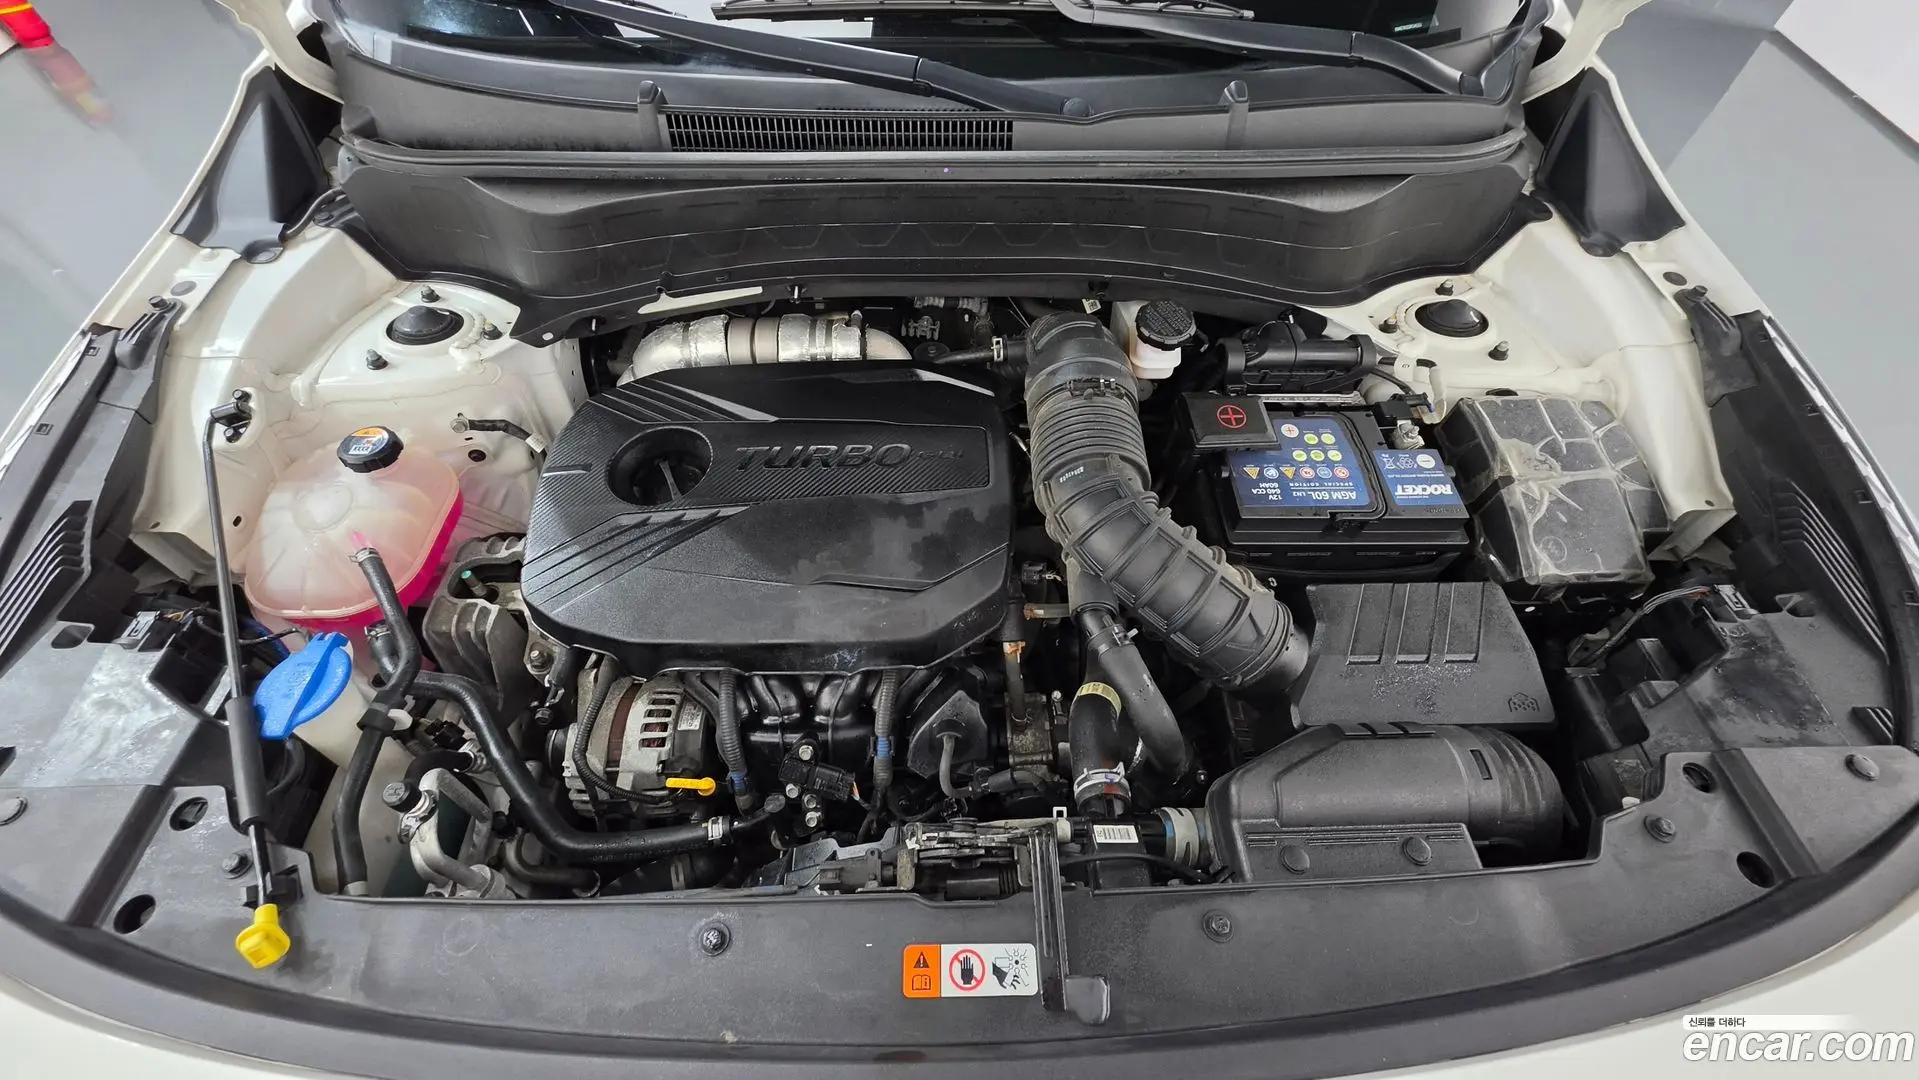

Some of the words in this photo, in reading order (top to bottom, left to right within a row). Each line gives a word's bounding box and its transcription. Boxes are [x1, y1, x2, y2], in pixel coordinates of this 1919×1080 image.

[736, 443, 912, 472] TURBO
[1395, 484, 1453, 495] ROCKET
[1307, 490, 1329, 500] 60L
[1331, 490, 1356, 500] AGM
